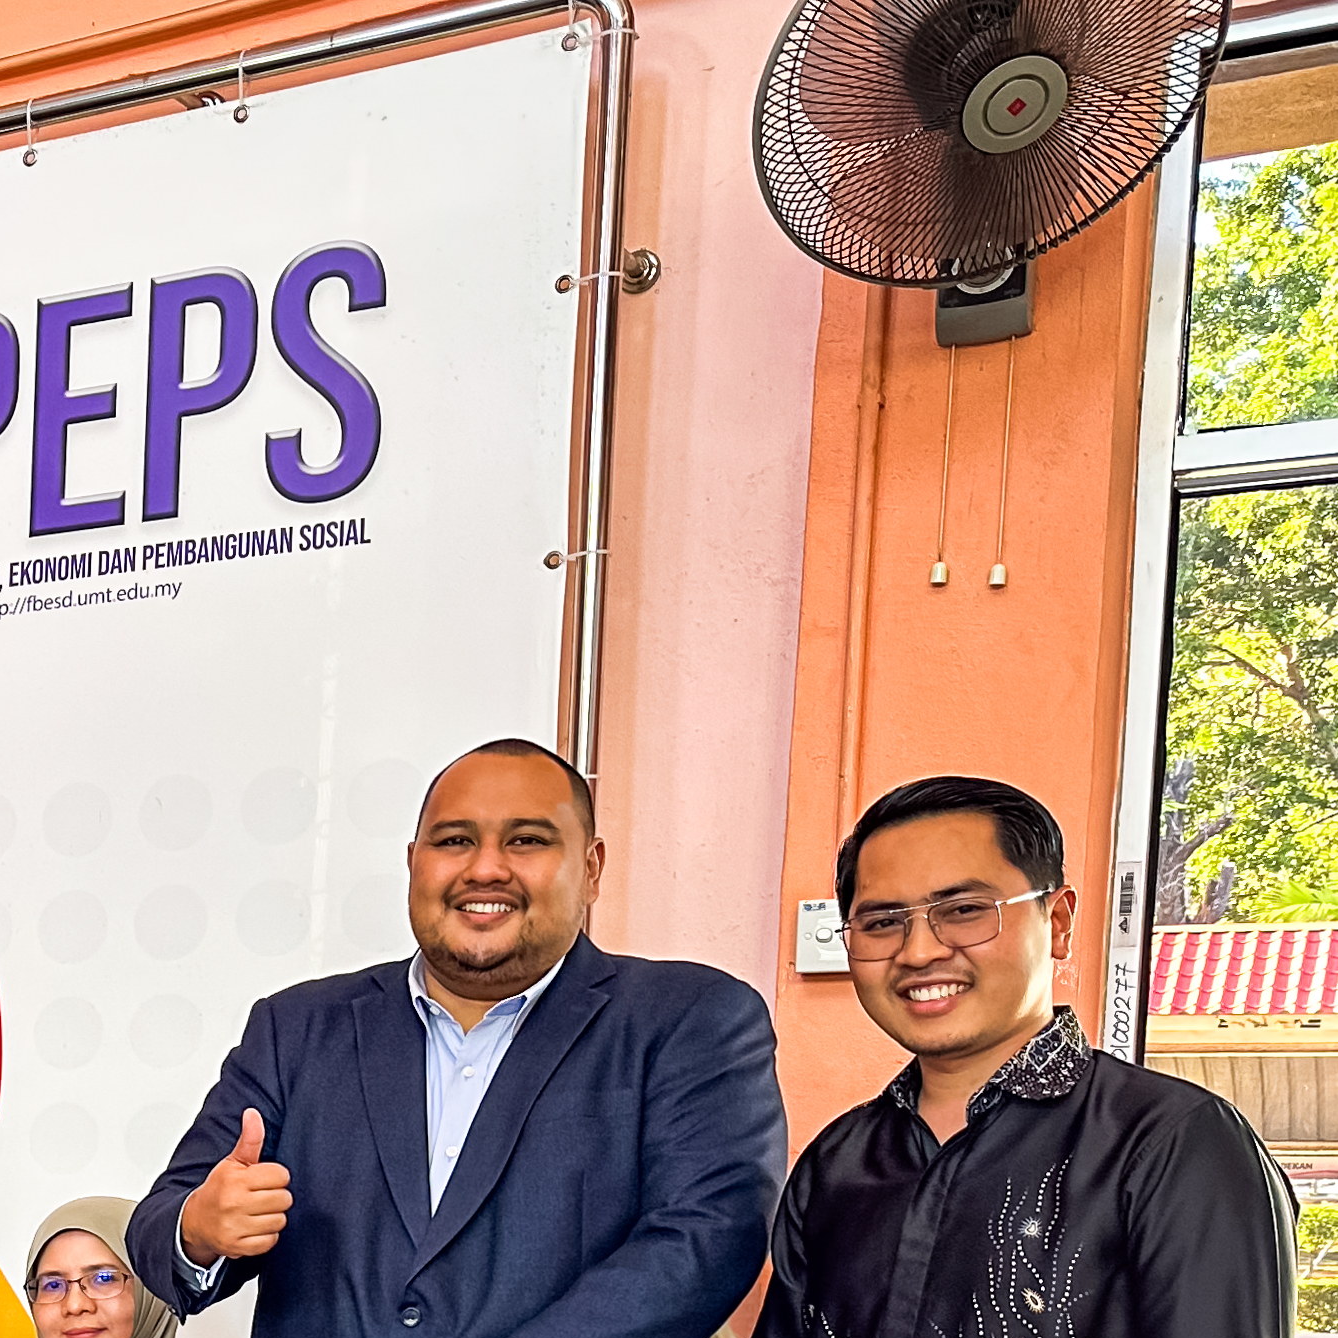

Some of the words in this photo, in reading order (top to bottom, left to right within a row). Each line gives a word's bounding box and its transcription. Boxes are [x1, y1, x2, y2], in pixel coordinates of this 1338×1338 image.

[8, 551, 94, 589] EKONOMI
[97, 546, 136, 576] DAN
[141, 526, 294, 573] PEMBANGUNAN
[298, 517, 372, 552] SOSIAL
